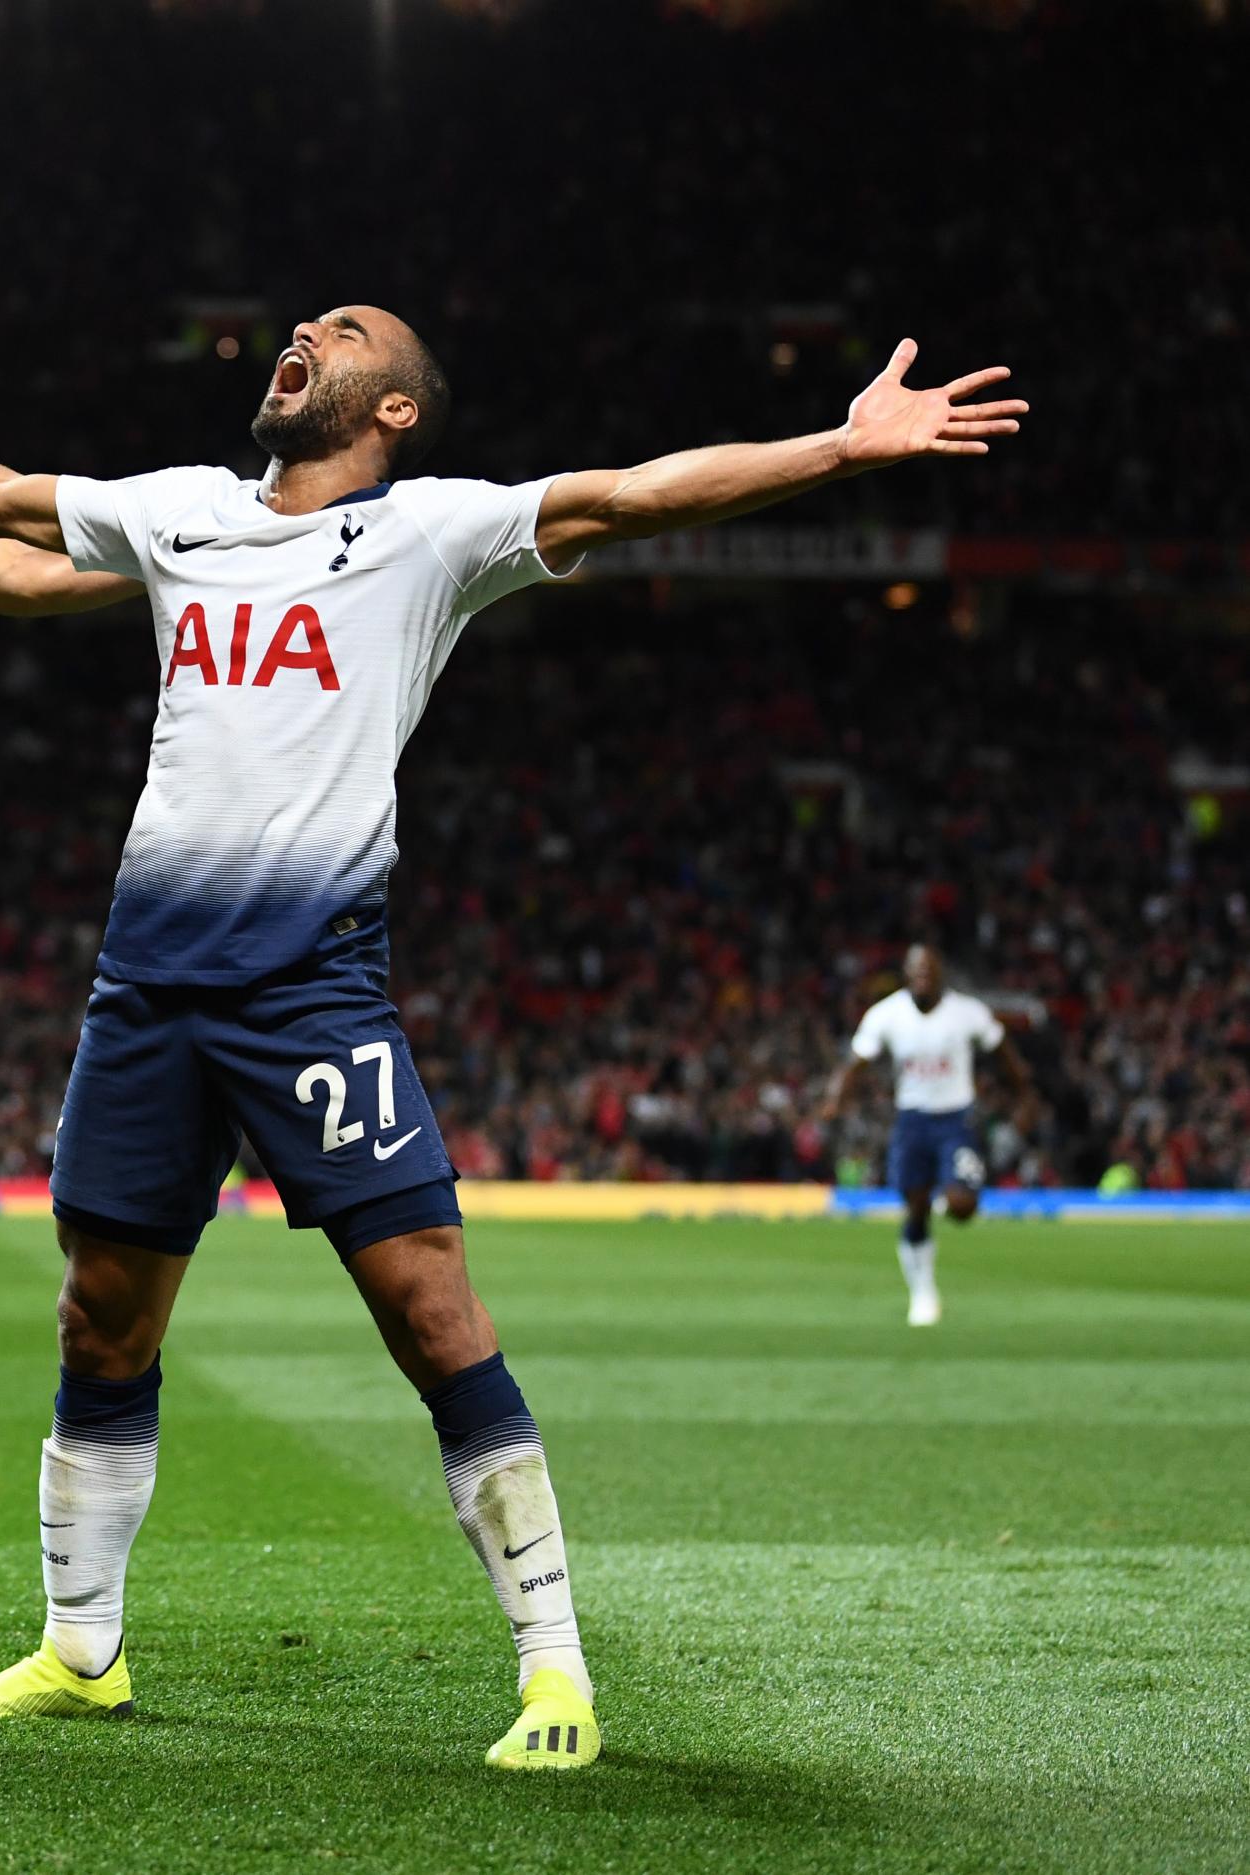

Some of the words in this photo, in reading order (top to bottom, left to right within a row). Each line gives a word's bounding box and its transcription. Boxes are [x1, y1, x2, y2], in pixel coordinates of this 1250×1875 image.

[166, 602, 341, 691] AIA
[295, 1041, 396, 1153] 27
[519, 1569, 565, 1594] SPURS
